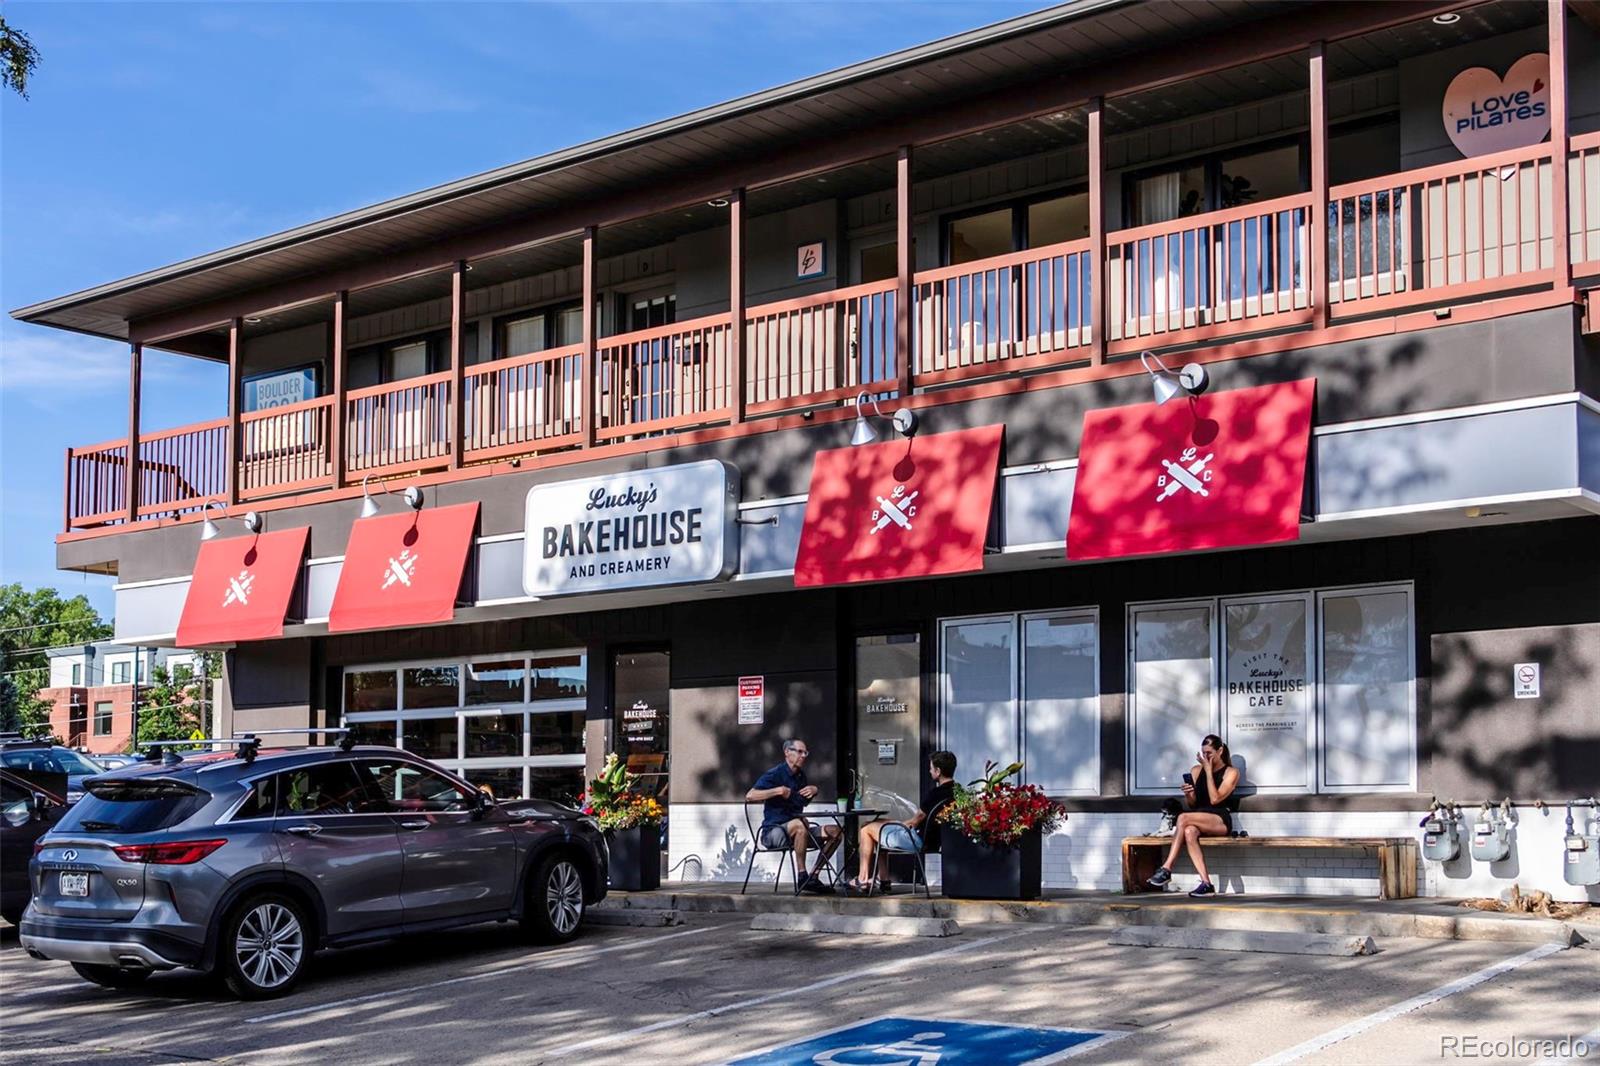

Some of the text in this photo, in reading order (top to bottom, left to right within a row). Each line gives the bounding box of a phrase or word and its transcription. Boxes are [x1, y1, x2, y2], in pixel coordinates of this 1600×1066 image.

[259, 378, 301, 400] BOULDER
[1158, 470, 1213, 487] B C
[586, 483, 658, 512] Lucky's
[872, 506, 916, 520] B C
[542, 508, 702, 559] BAKEHOUSE
[570, 556, 671, 579] AND CREAMERY
[1243, 652, 1289, 668] VISIT THE
[1249, 668, 1283, 679] Lucky's
[1229, 679, 1303, 695] BAKEHOUSE
[866, 703, 905, 712] BAKEHOUSE
[1249, 695, 1283, 707] CAFE
[623, 709, 657, 719] BAKEHOUSE
[116, 878, 138, 887] QX50
